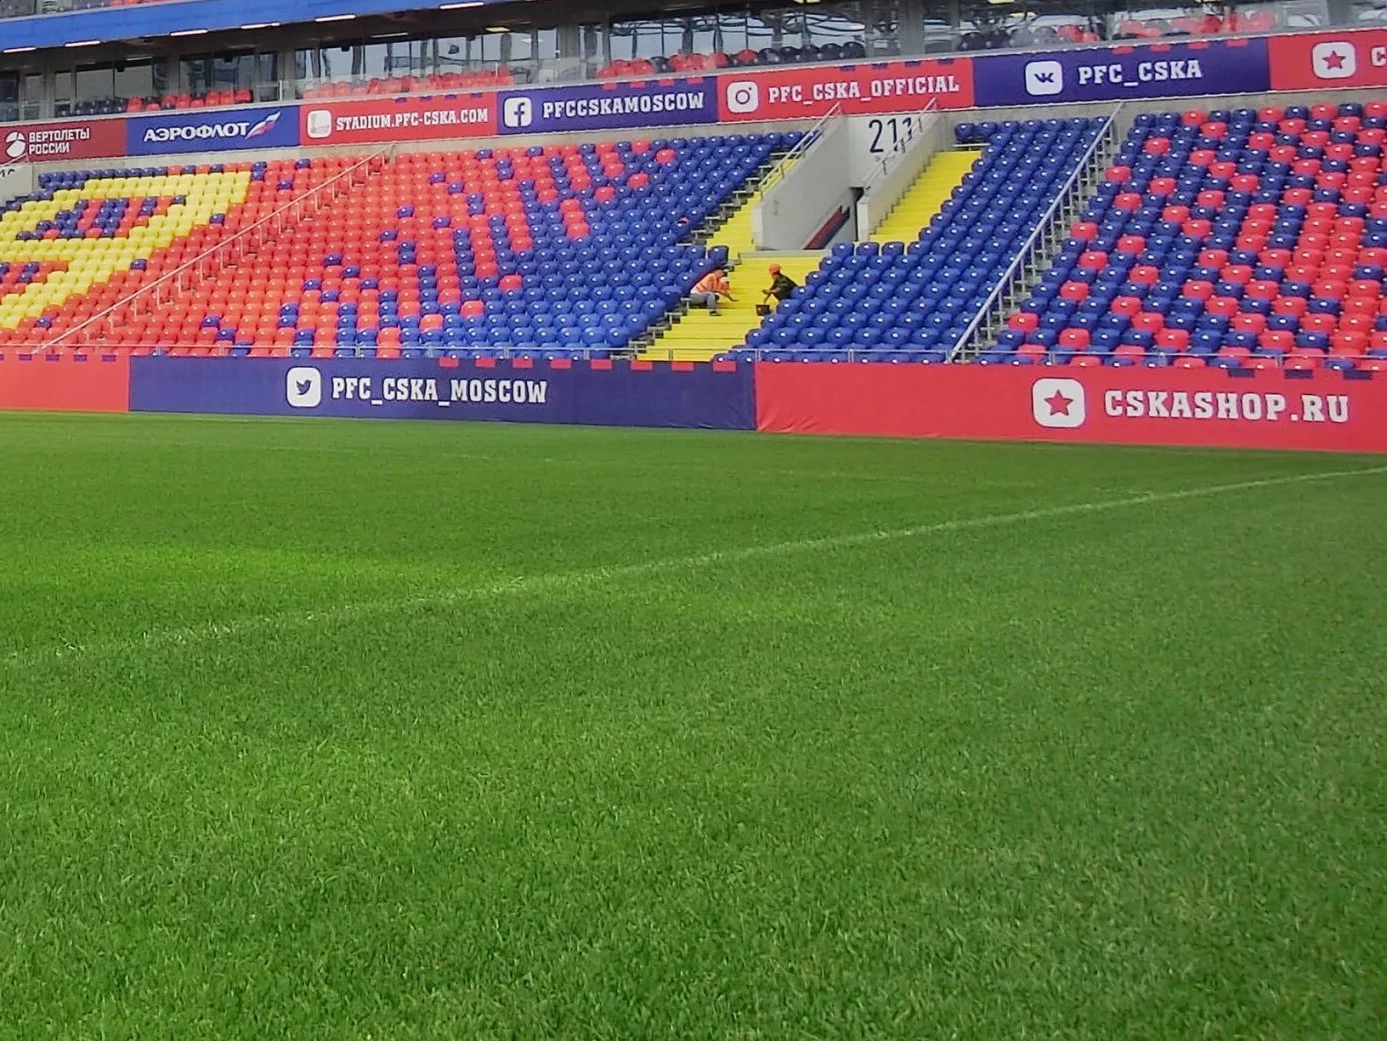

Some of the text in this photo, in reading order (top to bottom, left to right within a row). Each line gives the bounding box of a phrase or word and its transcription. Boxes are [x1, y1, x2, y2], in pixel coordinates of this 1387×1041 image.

[1078, 59, 1202, 88] PFC_CSKA
[768, 75, 959, 105] PFC_CSKA_OFFICIAL
[542, 92, 704, 119] PFCCSKAMOSCOW
[143, 121, 250, 143] АЭРОФЛОТ
[336, 108, 489, 131] STADIUM.PFC-CSKA.COM
[27, 141, 71, 155] РОССИИ
[28, 127, 91, 142] ВЕРТОЛЕТЫ
[331, 376, 549, 407] PFC_CSKA_MOSCOW
[1104, 389, 1350, 423] CSKASHOP.RU
